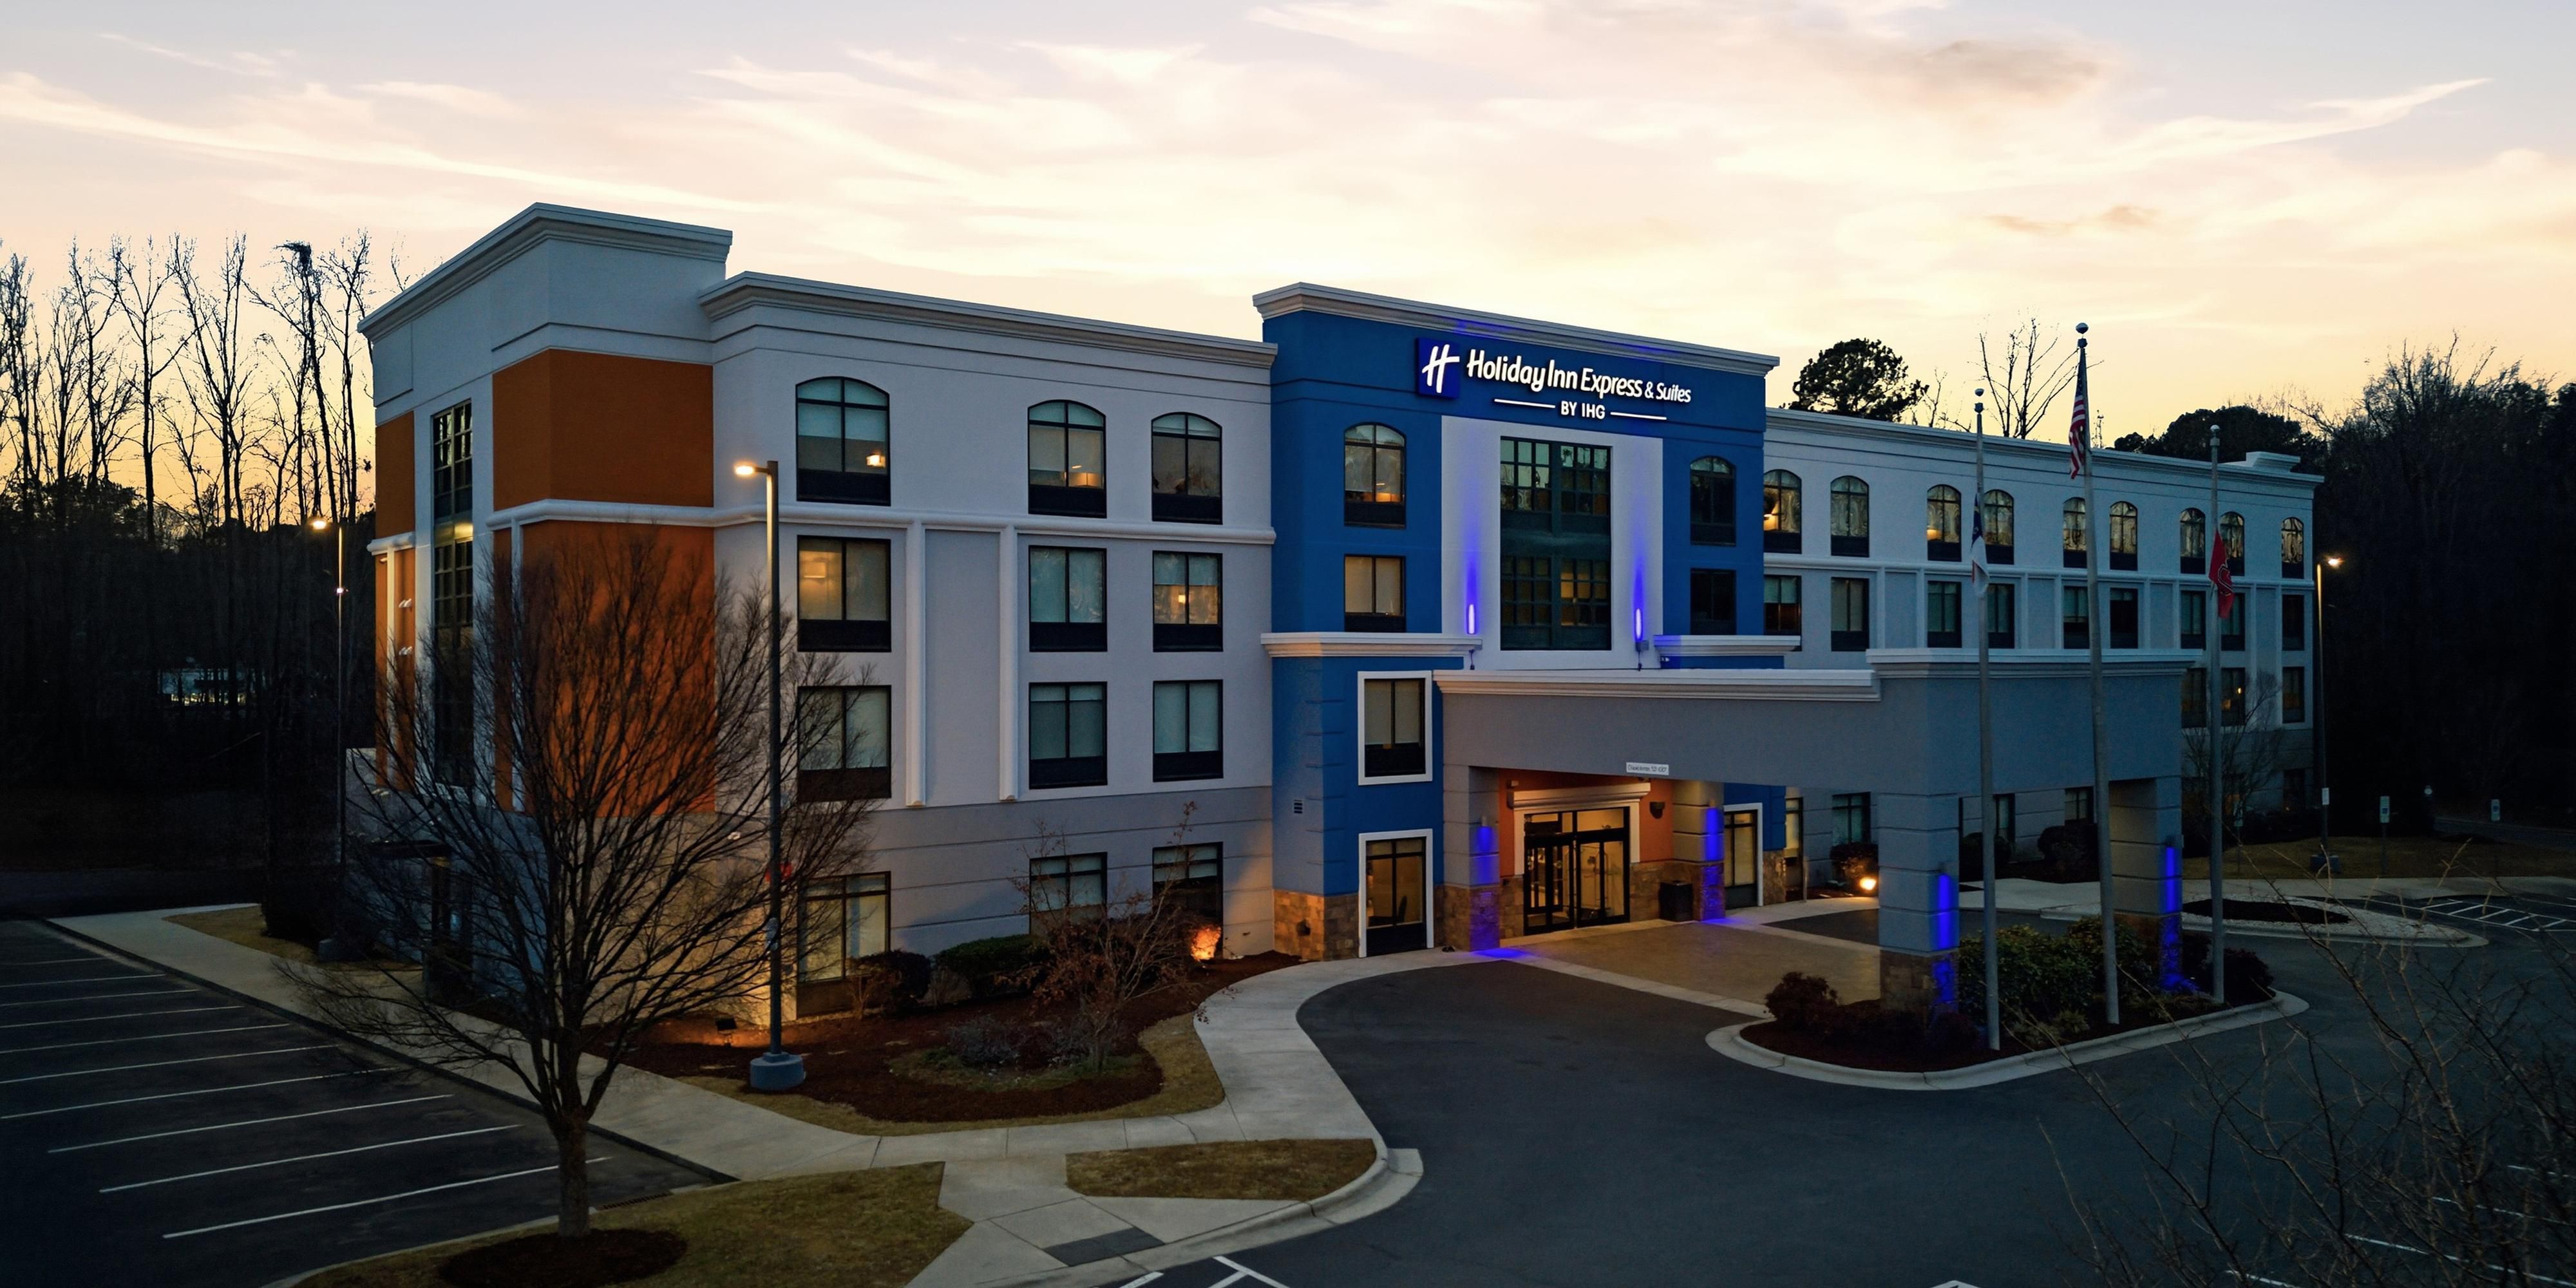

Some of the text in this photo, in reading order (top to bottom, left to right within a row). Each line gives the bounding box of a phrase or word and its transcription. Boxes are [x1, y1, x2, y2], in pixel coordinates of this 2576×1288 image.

[1466, 348, 1691, 403] Holiday Inn Express & Suites
[1560, 401, 1605, 419] BY IHG
